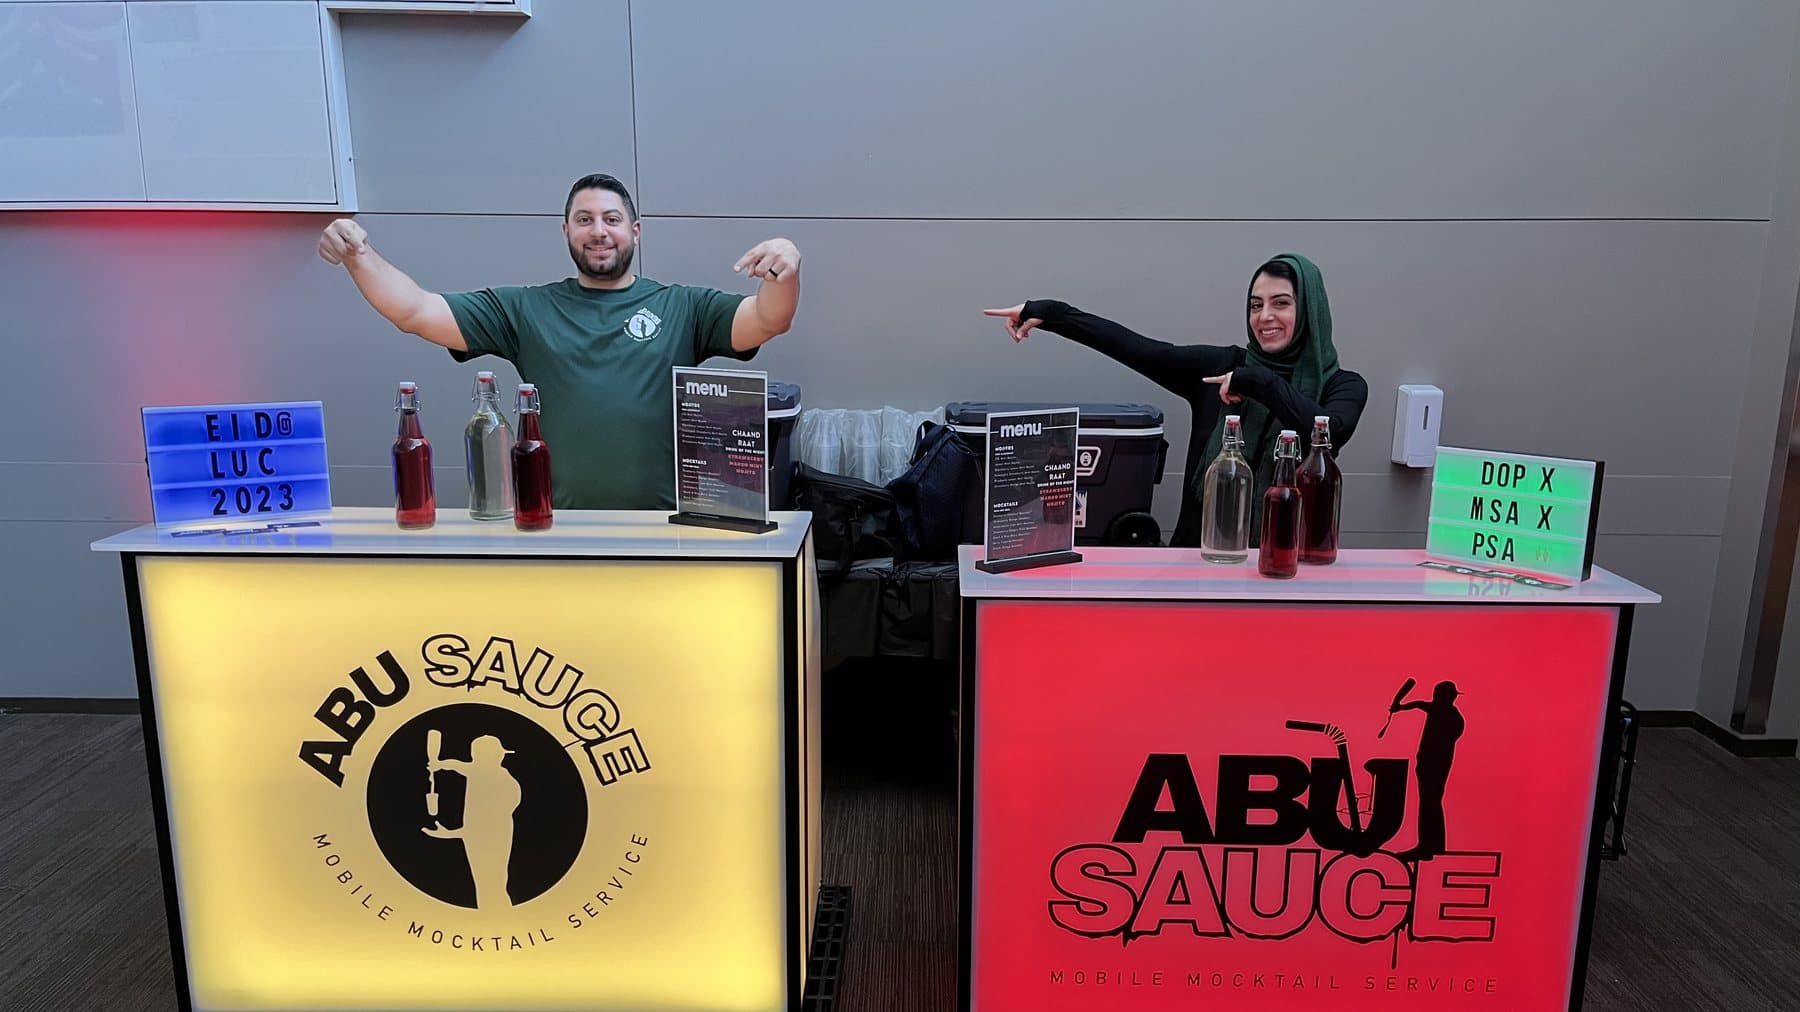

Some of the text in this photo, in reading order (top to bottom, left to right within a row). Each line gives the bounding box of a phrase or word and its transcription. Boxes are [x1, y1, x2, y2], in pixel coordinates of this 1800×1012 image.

[686, 381, 728, 397] menu
[732, 429, 761, 440] CHAAND
[737, 439, 755, 448] RAAT
[1000, 422, 1042, 438] menu
[210, 447, 276, 479] LUC
[1044, 463, 1071, 472] CHAAND
[1049, 472, 1066, 481] RAAT
[1481, 461, 1555, 493] DOP X
[210, 483, 294, 515] 2023
[1470, 496, 1553, 530] MSA X
[1471, 532, 1515, 562] PSA
[299, 633, 652, 788] ABU SAUCE
[1111, 753, 1410, 857] ABU
[312, 833, 649, 951] MOBILE MOCKTAIL SERVICE
[1047, 843, 1502, 945] SAUCE
[1049, 970, 1498, 994] MOBILE MOCKTAIL SERVICE
